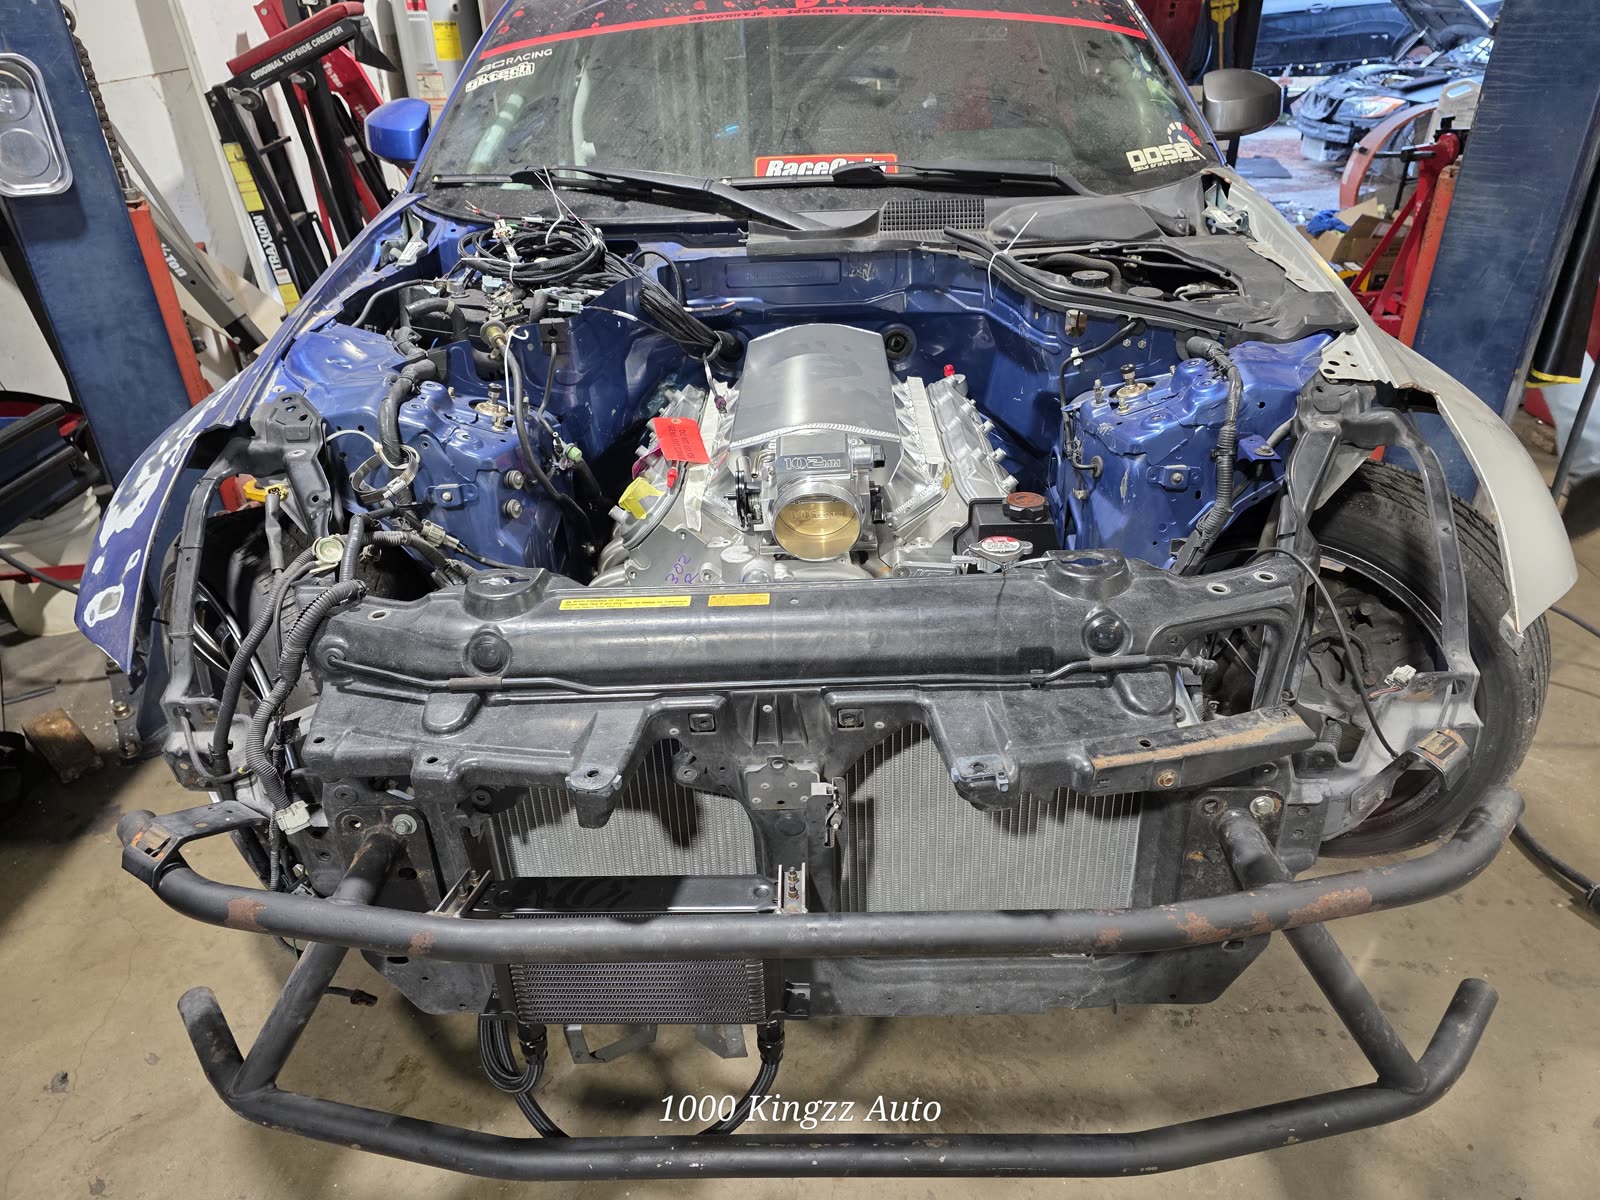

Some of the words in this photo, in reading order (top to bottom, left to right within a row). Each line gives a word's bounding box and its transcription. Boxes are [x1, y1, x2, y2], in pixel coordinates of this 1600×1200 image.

[250, 59, 284, 80] ORIGINAL
[282, 42, 313, 63] TOPSIDE
[311, 25, 344, 47] CREEPER
[1126, 143, 1194, 168] DDSB
[252, 214, 283, 271] TRAXION
